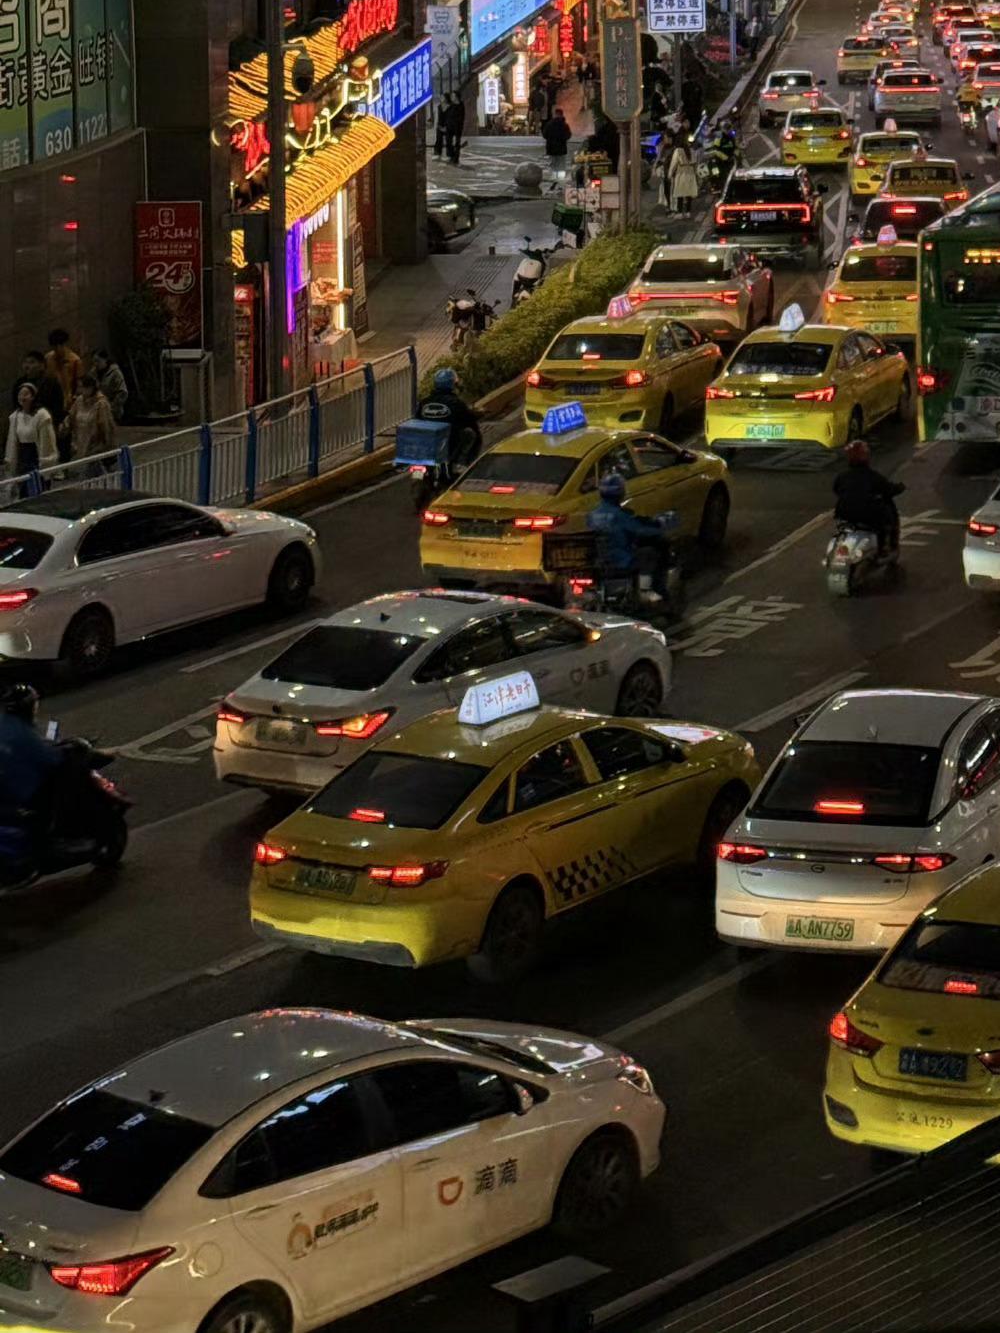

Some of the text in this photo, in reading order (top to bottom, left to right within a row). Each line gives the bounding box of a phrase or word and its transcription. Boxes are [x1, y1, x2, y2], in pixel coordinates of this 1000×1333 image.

[654, 14, 700, 27] 严禁停车
[45, 127, 72, 157] 630
[78, 113, 107, 145] 1122
[475, 1157, 519, 1196] 滴滴
